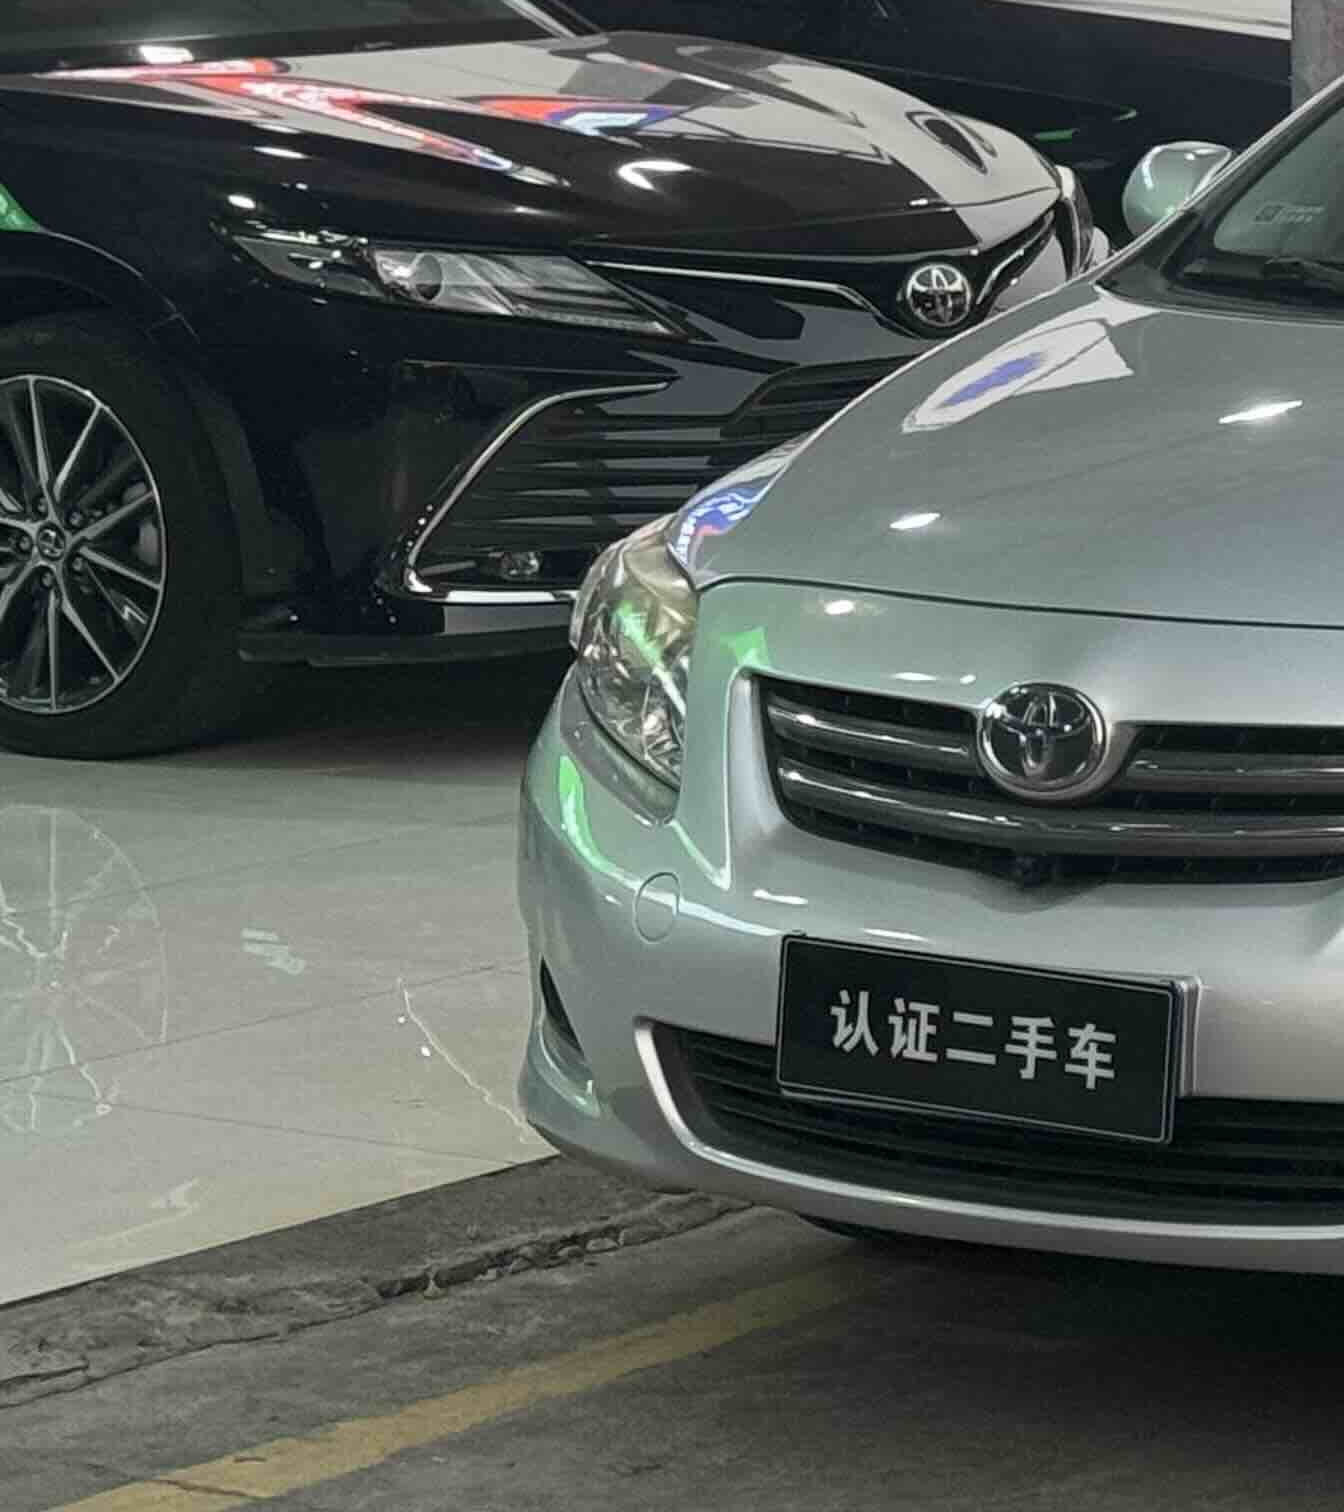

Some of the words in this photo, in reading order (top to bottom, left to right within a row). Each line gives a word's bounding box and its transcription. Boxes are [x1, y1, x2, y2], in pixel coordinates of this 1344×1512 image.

[830, 990, 1117, 1089] 认证二手车
